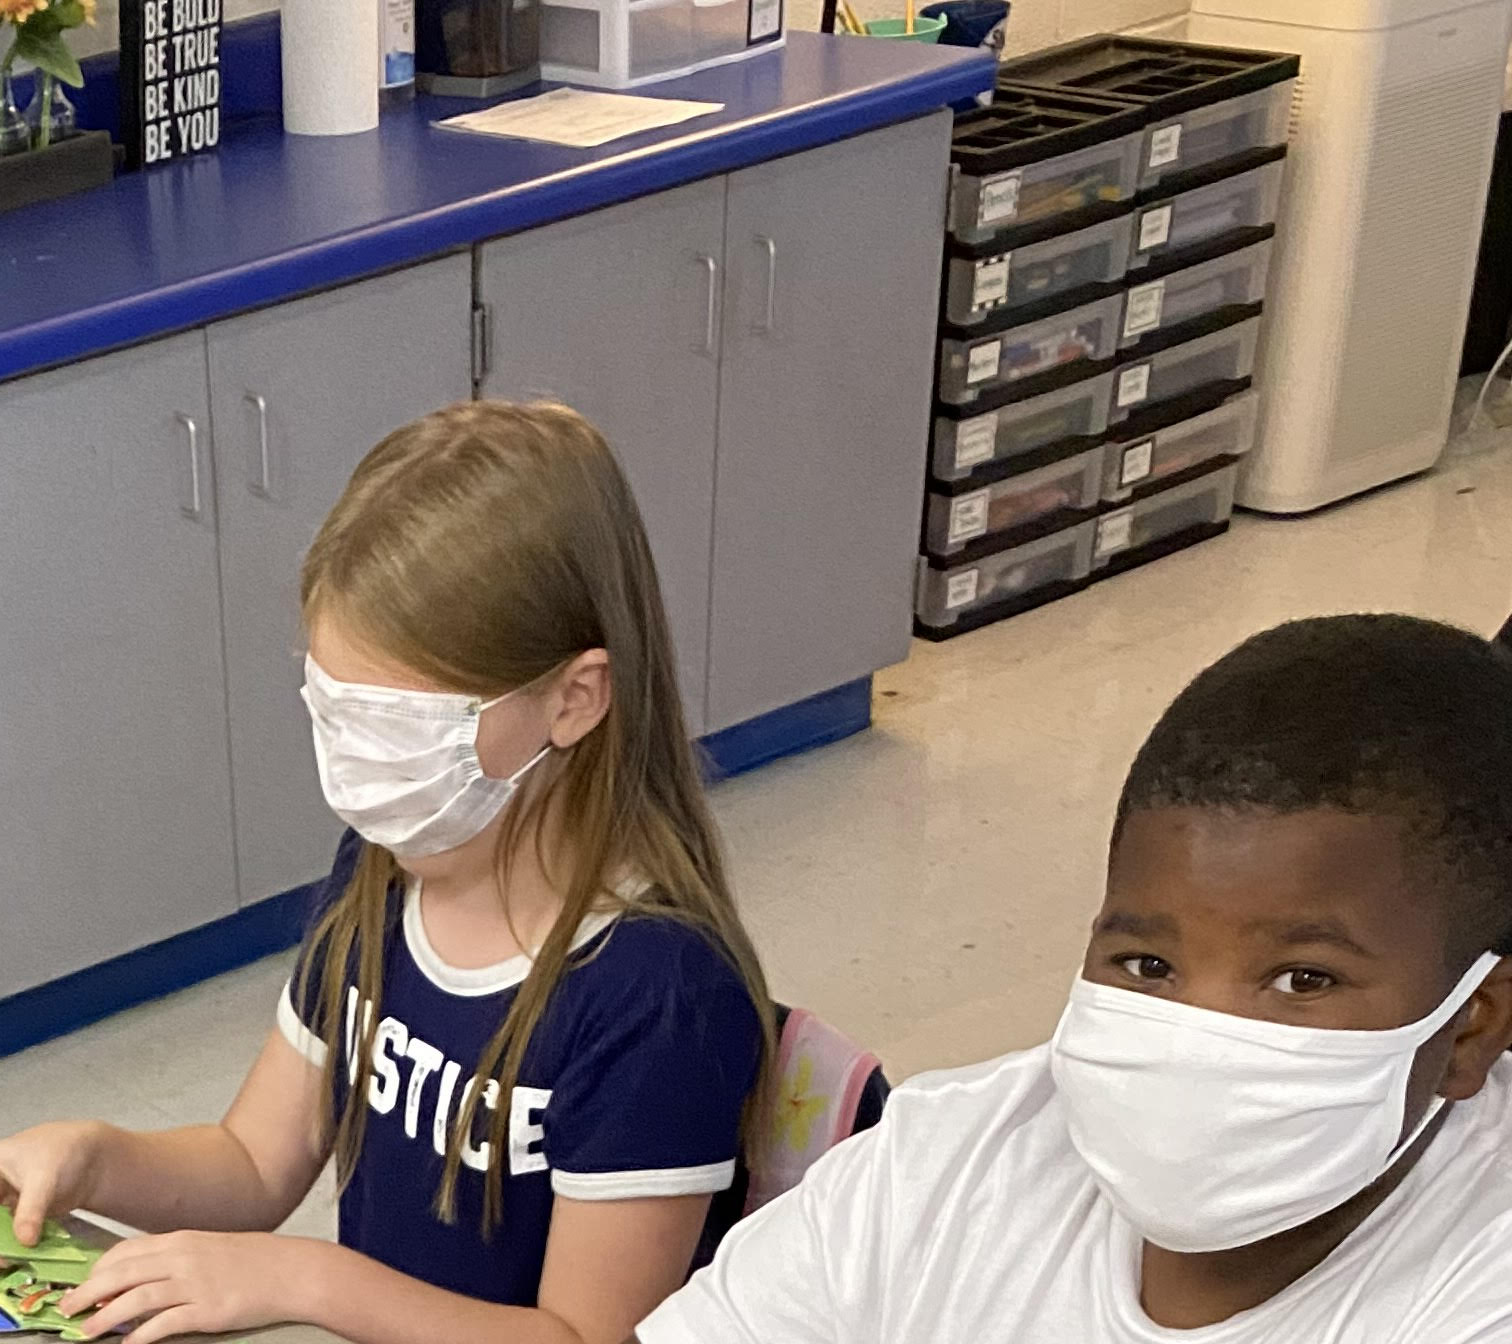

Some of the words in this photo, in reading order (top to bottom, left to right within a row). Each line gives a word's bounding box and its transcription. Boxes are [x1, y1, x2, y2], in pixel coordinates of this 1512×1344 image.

[143, 0, 168, 40] BE
[144, 39, 168, 81] BE
[172, 26, 220, 74] TRUE
[144, 81, 169, 121] BE
[173, 69, 220, 114] KIND
[144, 120, 172, 163] BE
[177, 107, 220, 154] YOU
[345, 984, 555, 1177] USTICE
